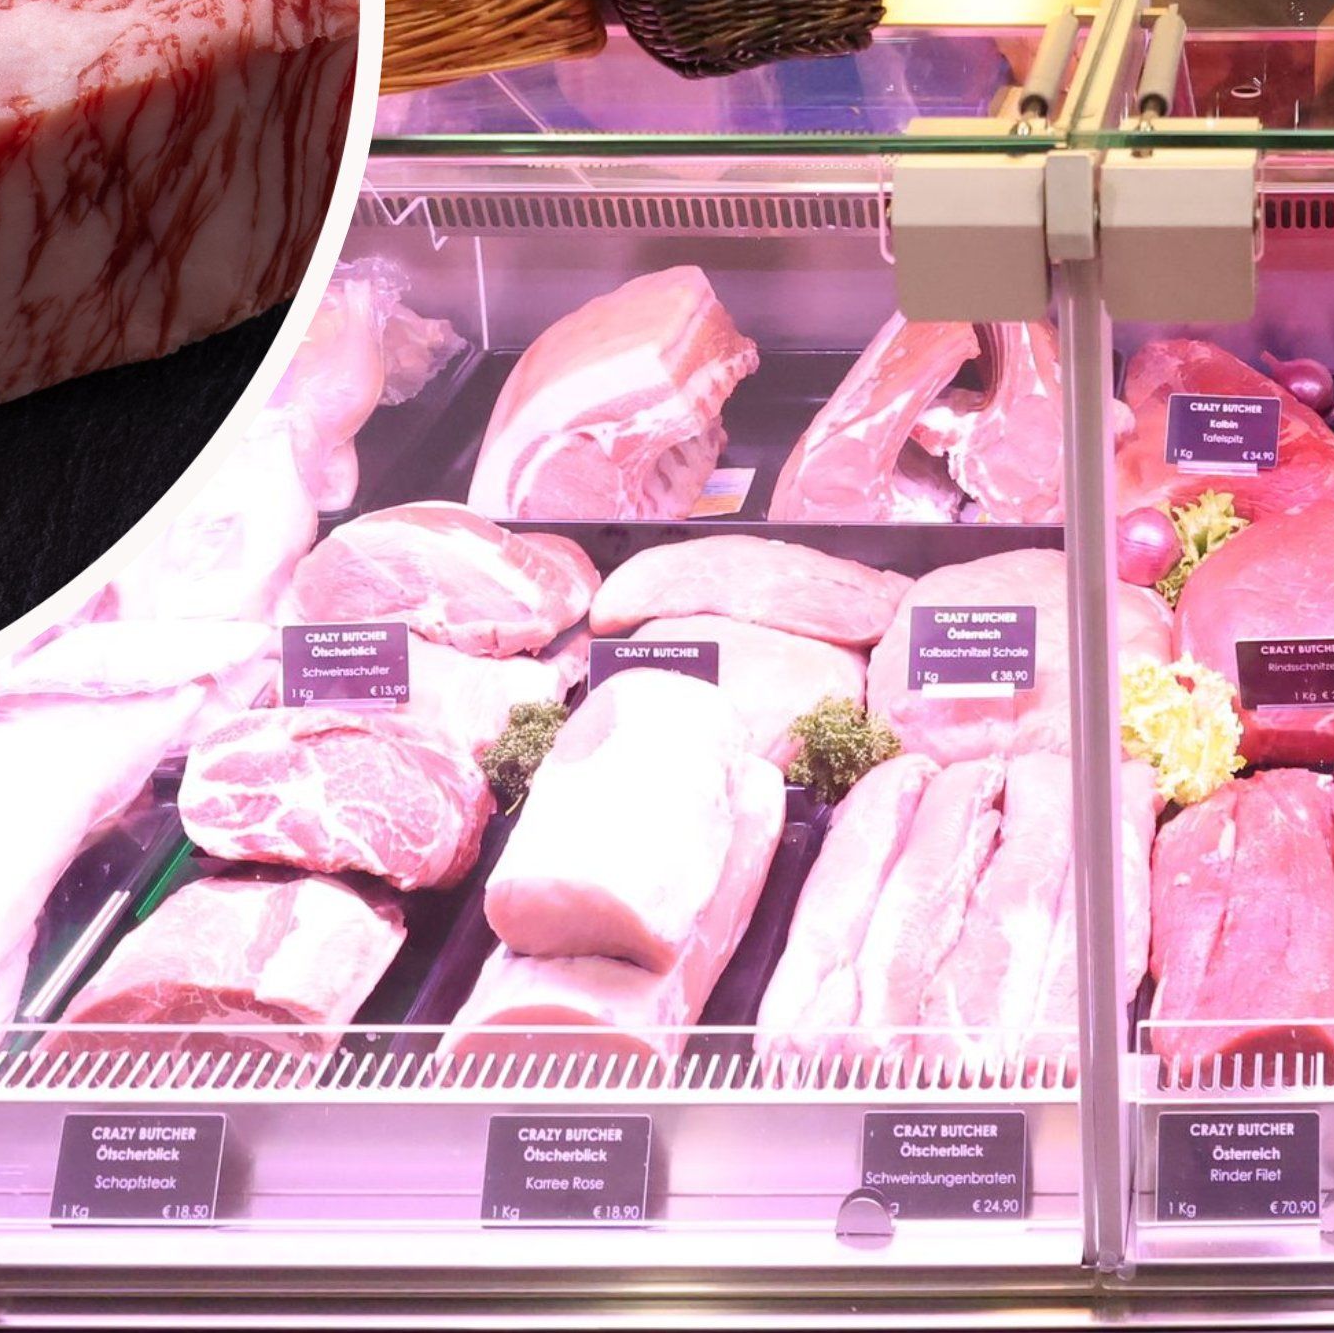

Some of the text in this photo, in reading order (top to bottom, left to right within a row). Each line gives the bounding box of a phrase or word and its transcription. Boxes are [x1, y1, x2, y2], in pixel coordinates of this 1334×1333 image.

[1190, 402, 1262, 414] CRAZY BUTCHER
[1209, 420, 1239, 428] Kalbin
[1203, 434, 1244, 444] Tafelspitz
[1180, 449, 1274, 460] Kg € 34.90
[935, 612, 1018, 624] CRAZY BUTCHER
[305, 631, 387, 643] CRAZY BUTCHER
[947, 627, 1002, 640] Österreich
[311, 646, 377, 658] Ötscherblick
[615, 648, 699, 658] CRAZY BUTCHER
[919, 647, 1029, 658] Kalbsschnitzel Schale
[1260, 645, 1295, 654] CRAZY
[917, 671, 1028, 683] 1 Kg € 38.90
[292, 685, 406, 699] 1 Kg € 13.90
[1295, 692, 1299, 700] 1
[1302, 691, 1316, 702] Kg
[1322, 691, 1329, 699] €
[92, 1127, 196, 1140] CRAZY BUTCHER
[518, 1128, 622, 1141] CRAZY BUTCHER
[893, 1124, 998, 1137] CRAZY BUTCHER
[1189, 1123, 1295, 1136] CRAZY BUTCHER
[96, 1145, 180, 1161] Ötscherblick
[524, 1146, 607, 1162] Ötscherblick
[900, 1142, 984, 1157] Ötscherblick
[1212, 1145, 1281, 1160] Österreich
[865, 1171, 1016, 1187] Schweinslungenbraten
[1210, 1168, 1281, 1181] Rinder Filet
[95, 1175, 177, 1191] Schopfsteak
[525, 1177, 605, 1190] Karree Rose
[62, 1205, 209, 1218] 1 Kg € 18.50
[492, 1206, 639, 1219] 1 Kg € 18.90
[972, 1200, 1019, 1213] € 24.90
[1169, 1201, 1316, 1217] 1 Kg € 70.90
